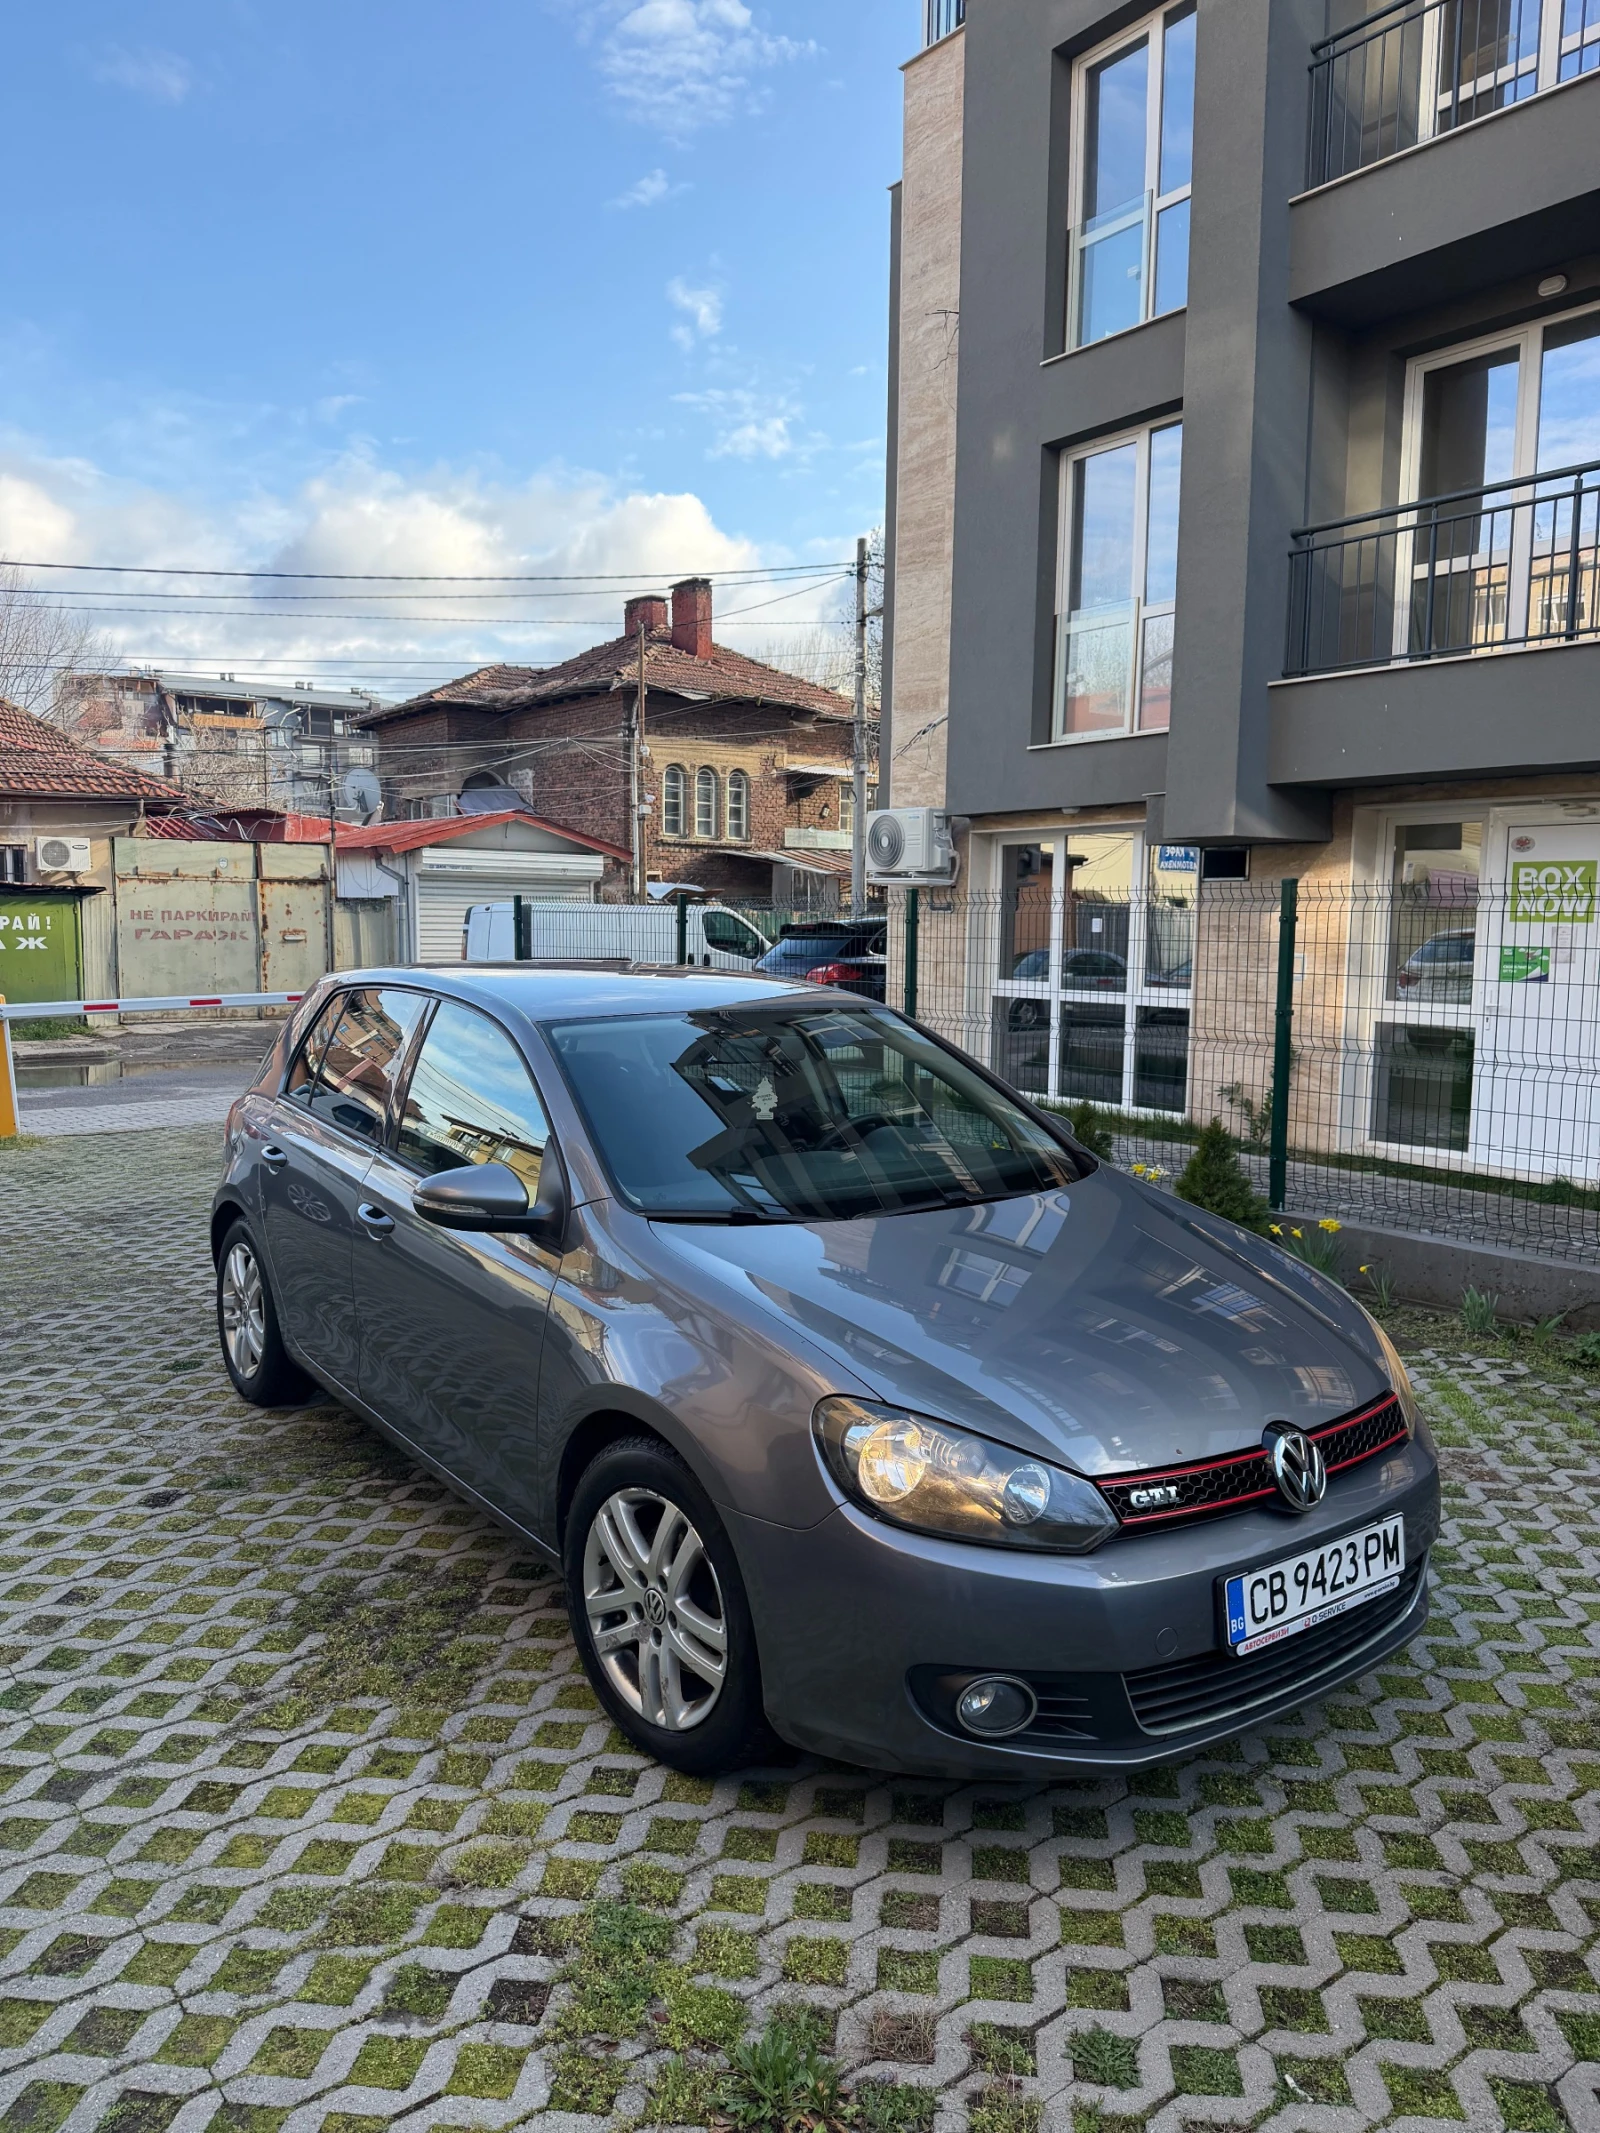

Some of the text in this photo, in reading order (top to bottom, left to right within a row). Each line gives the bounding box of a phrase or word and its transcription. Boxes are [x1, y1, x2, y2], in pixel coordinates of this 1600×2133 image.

[1519, 867, 1586, 891] BOX
[130, 910, 154, 920] НЕ
[1517, 893, 1589, 917] NOW
[135, 929, 249, 941] ГАРАЖ
[1130, 1486, 1178, 1509] GTI
[1250, 1525, 1400, 1625] CB 9423 PM
[1231, 1617, 1244, 1634] BG
